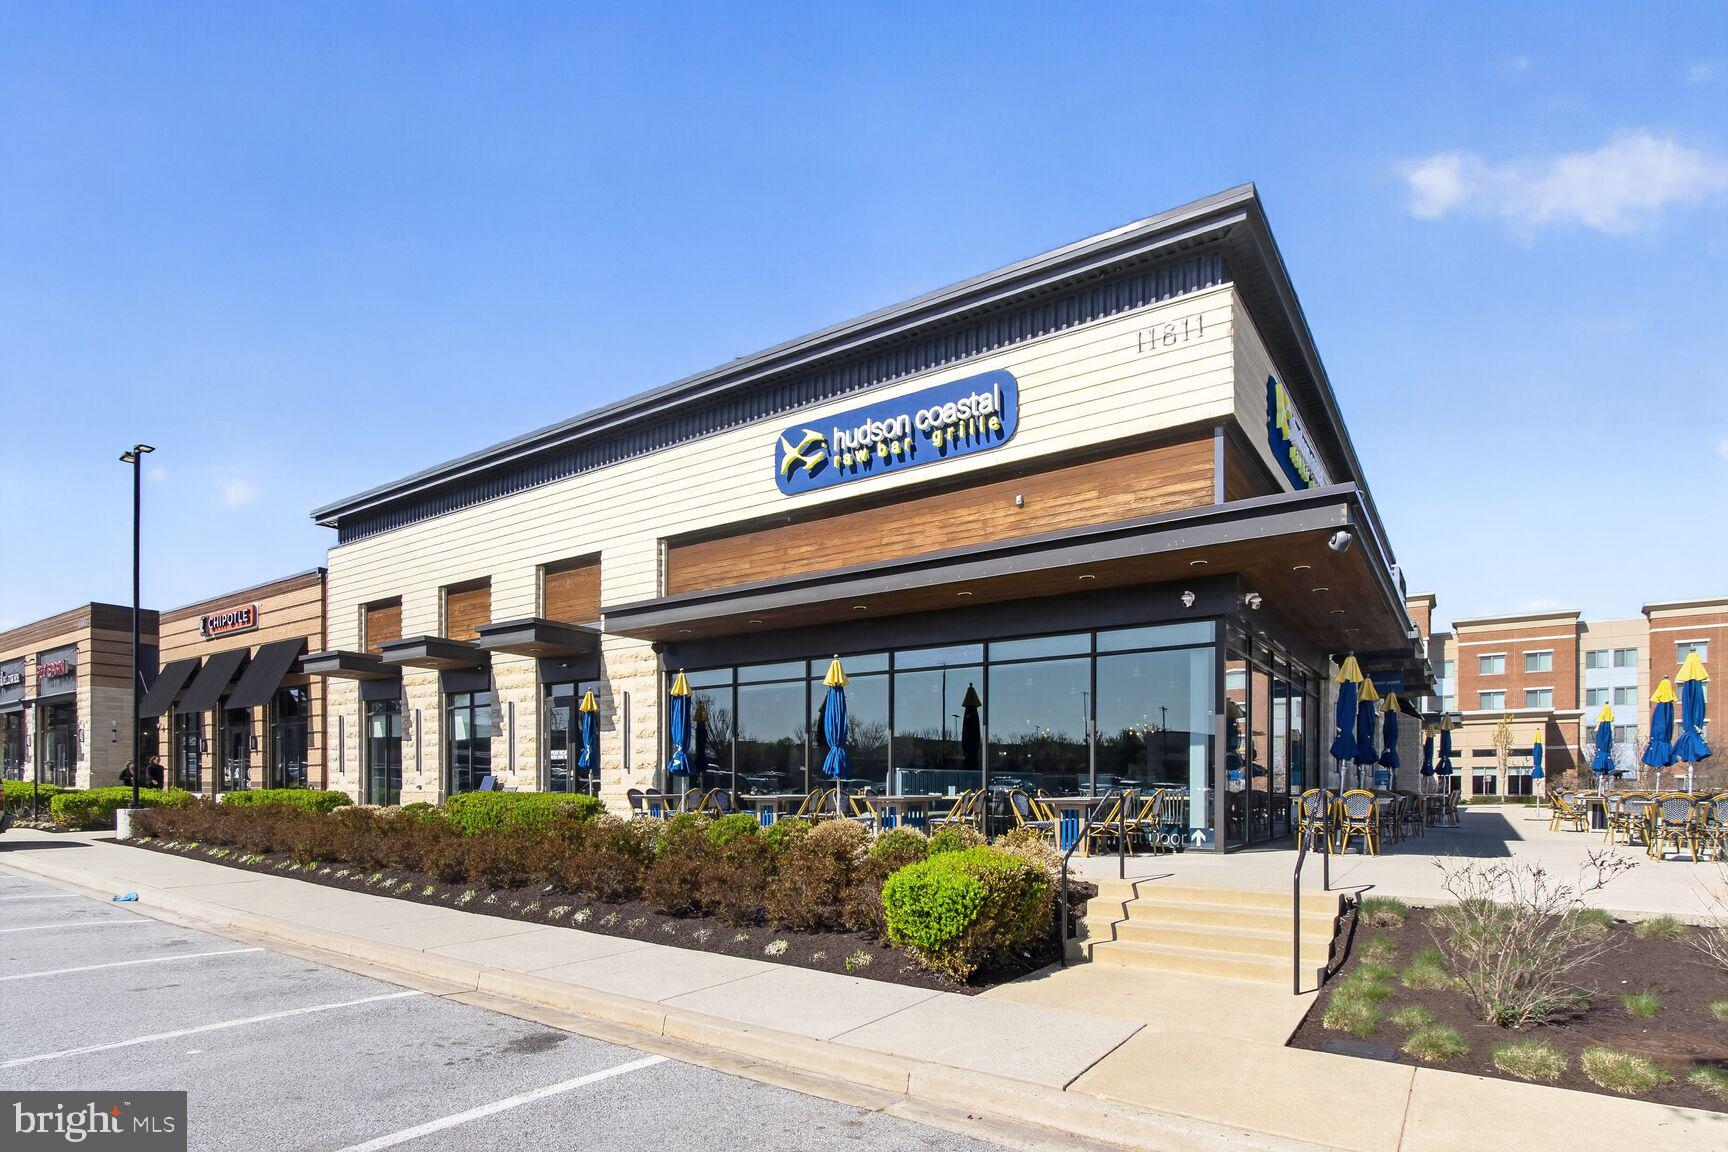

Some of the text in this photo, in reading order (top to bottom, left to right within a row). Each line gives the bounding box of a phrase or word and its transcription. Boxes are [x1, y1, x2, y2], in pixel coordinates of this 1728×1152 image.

[1136, 314, 1204, 353] 11811
[833, 382, 1000, 451] hudson coastal
[833, 415, 1001, 469] raw bar grille
[207, 608, 249, 629] CHIPOTLE
[1149, 830, 1188, 845] Door
